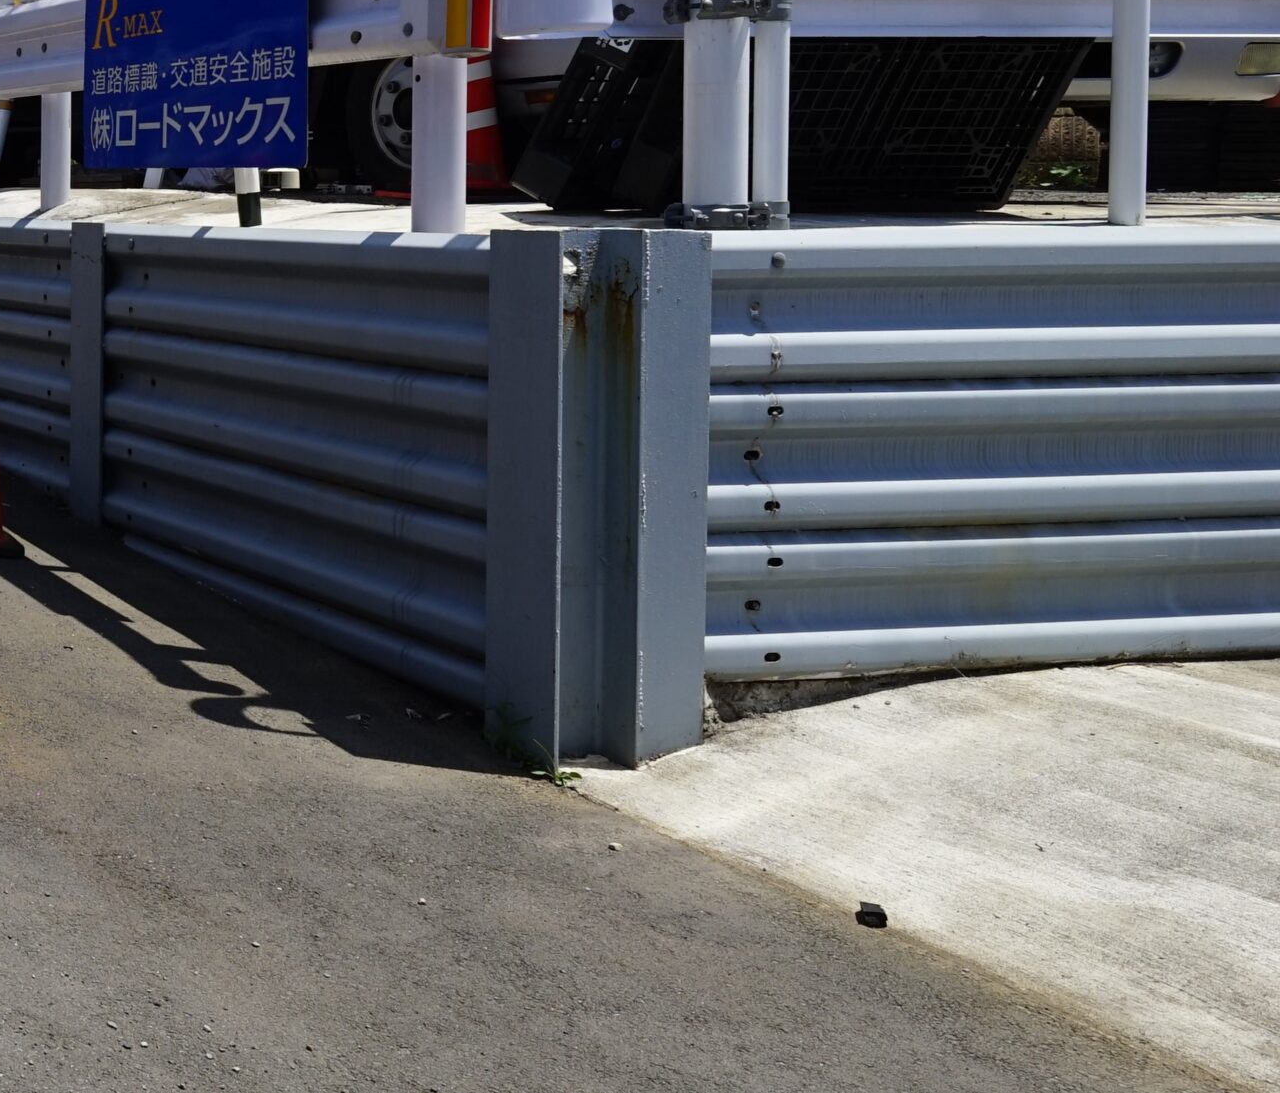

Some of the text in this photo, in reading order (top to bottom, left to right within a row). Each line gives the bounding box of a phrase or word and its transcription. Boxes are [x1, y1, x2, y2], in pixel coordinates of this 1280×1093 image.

[91, 46, 296, 96] 道路標識・交通安全施設
